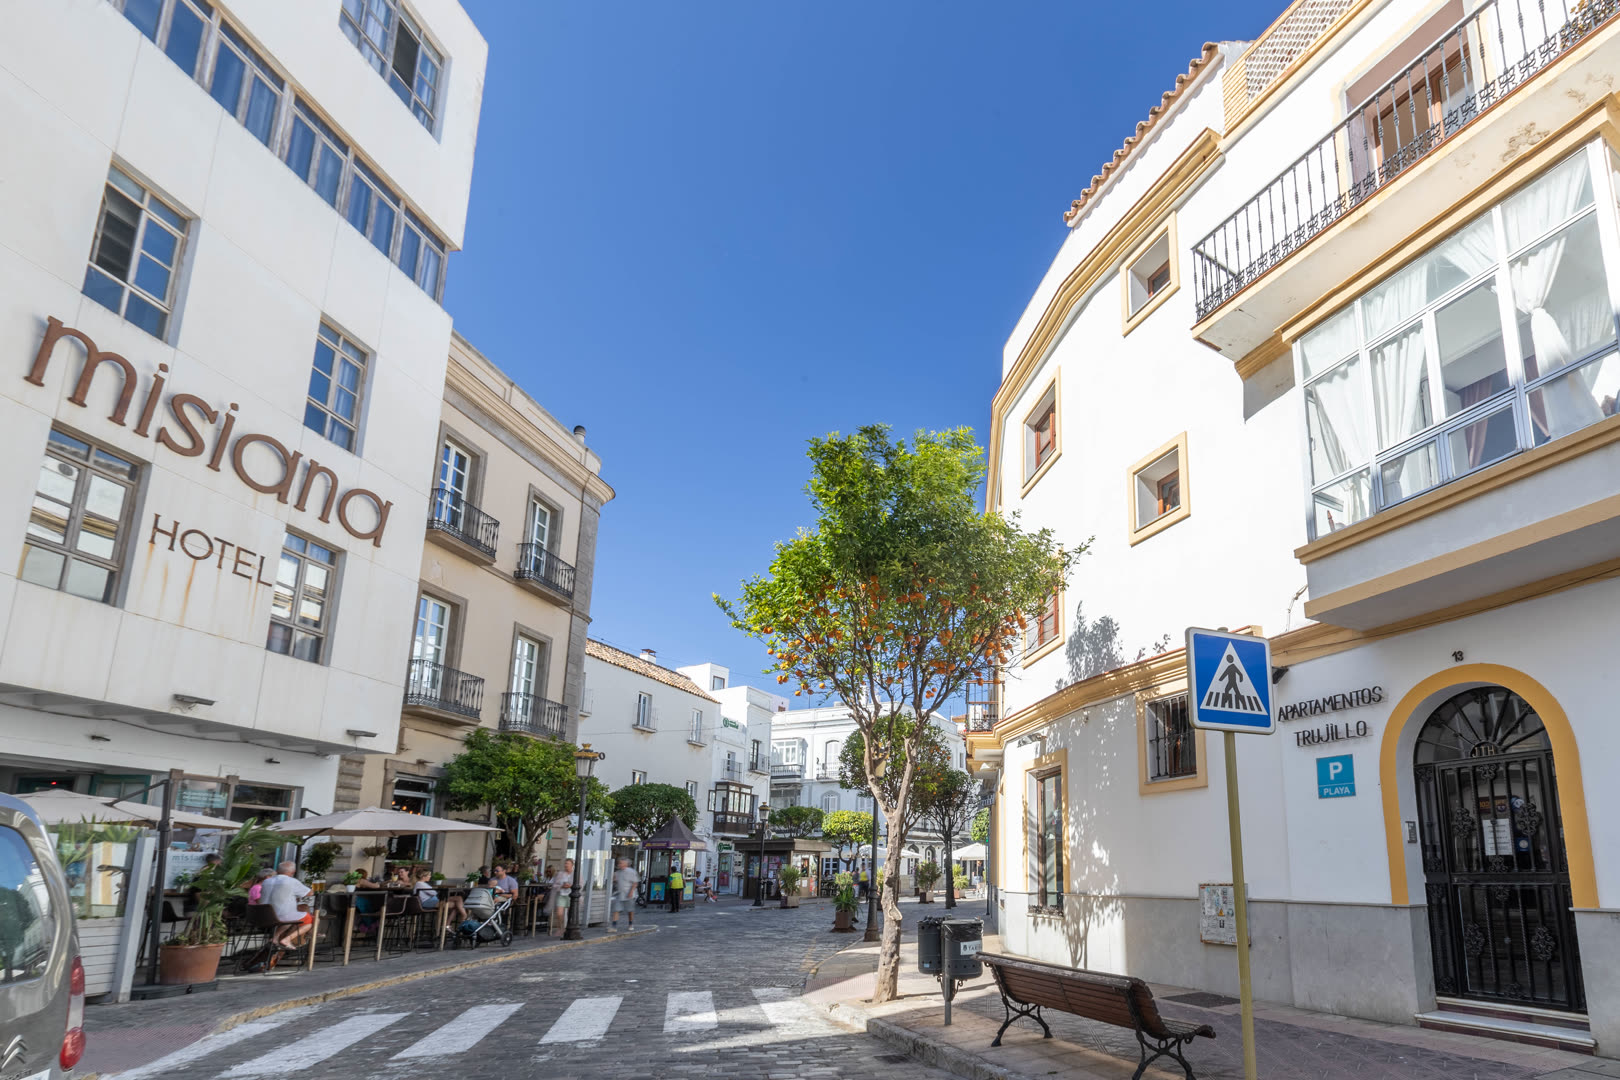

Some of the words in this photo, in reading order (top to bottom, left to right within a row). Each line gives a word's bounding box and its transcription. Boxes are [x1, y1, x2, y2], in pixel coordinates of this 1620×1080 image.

[24, 315, 394, 548] misiana
[148, 513, 273, 588] HOTEL
[1451, 650, 1464, 662] 13
[1277, 686, 1382, 721] APARTAMENTOS
[1329, 761, 1343, 780] P
[1323, 786, 1350, 796] PLAYA
